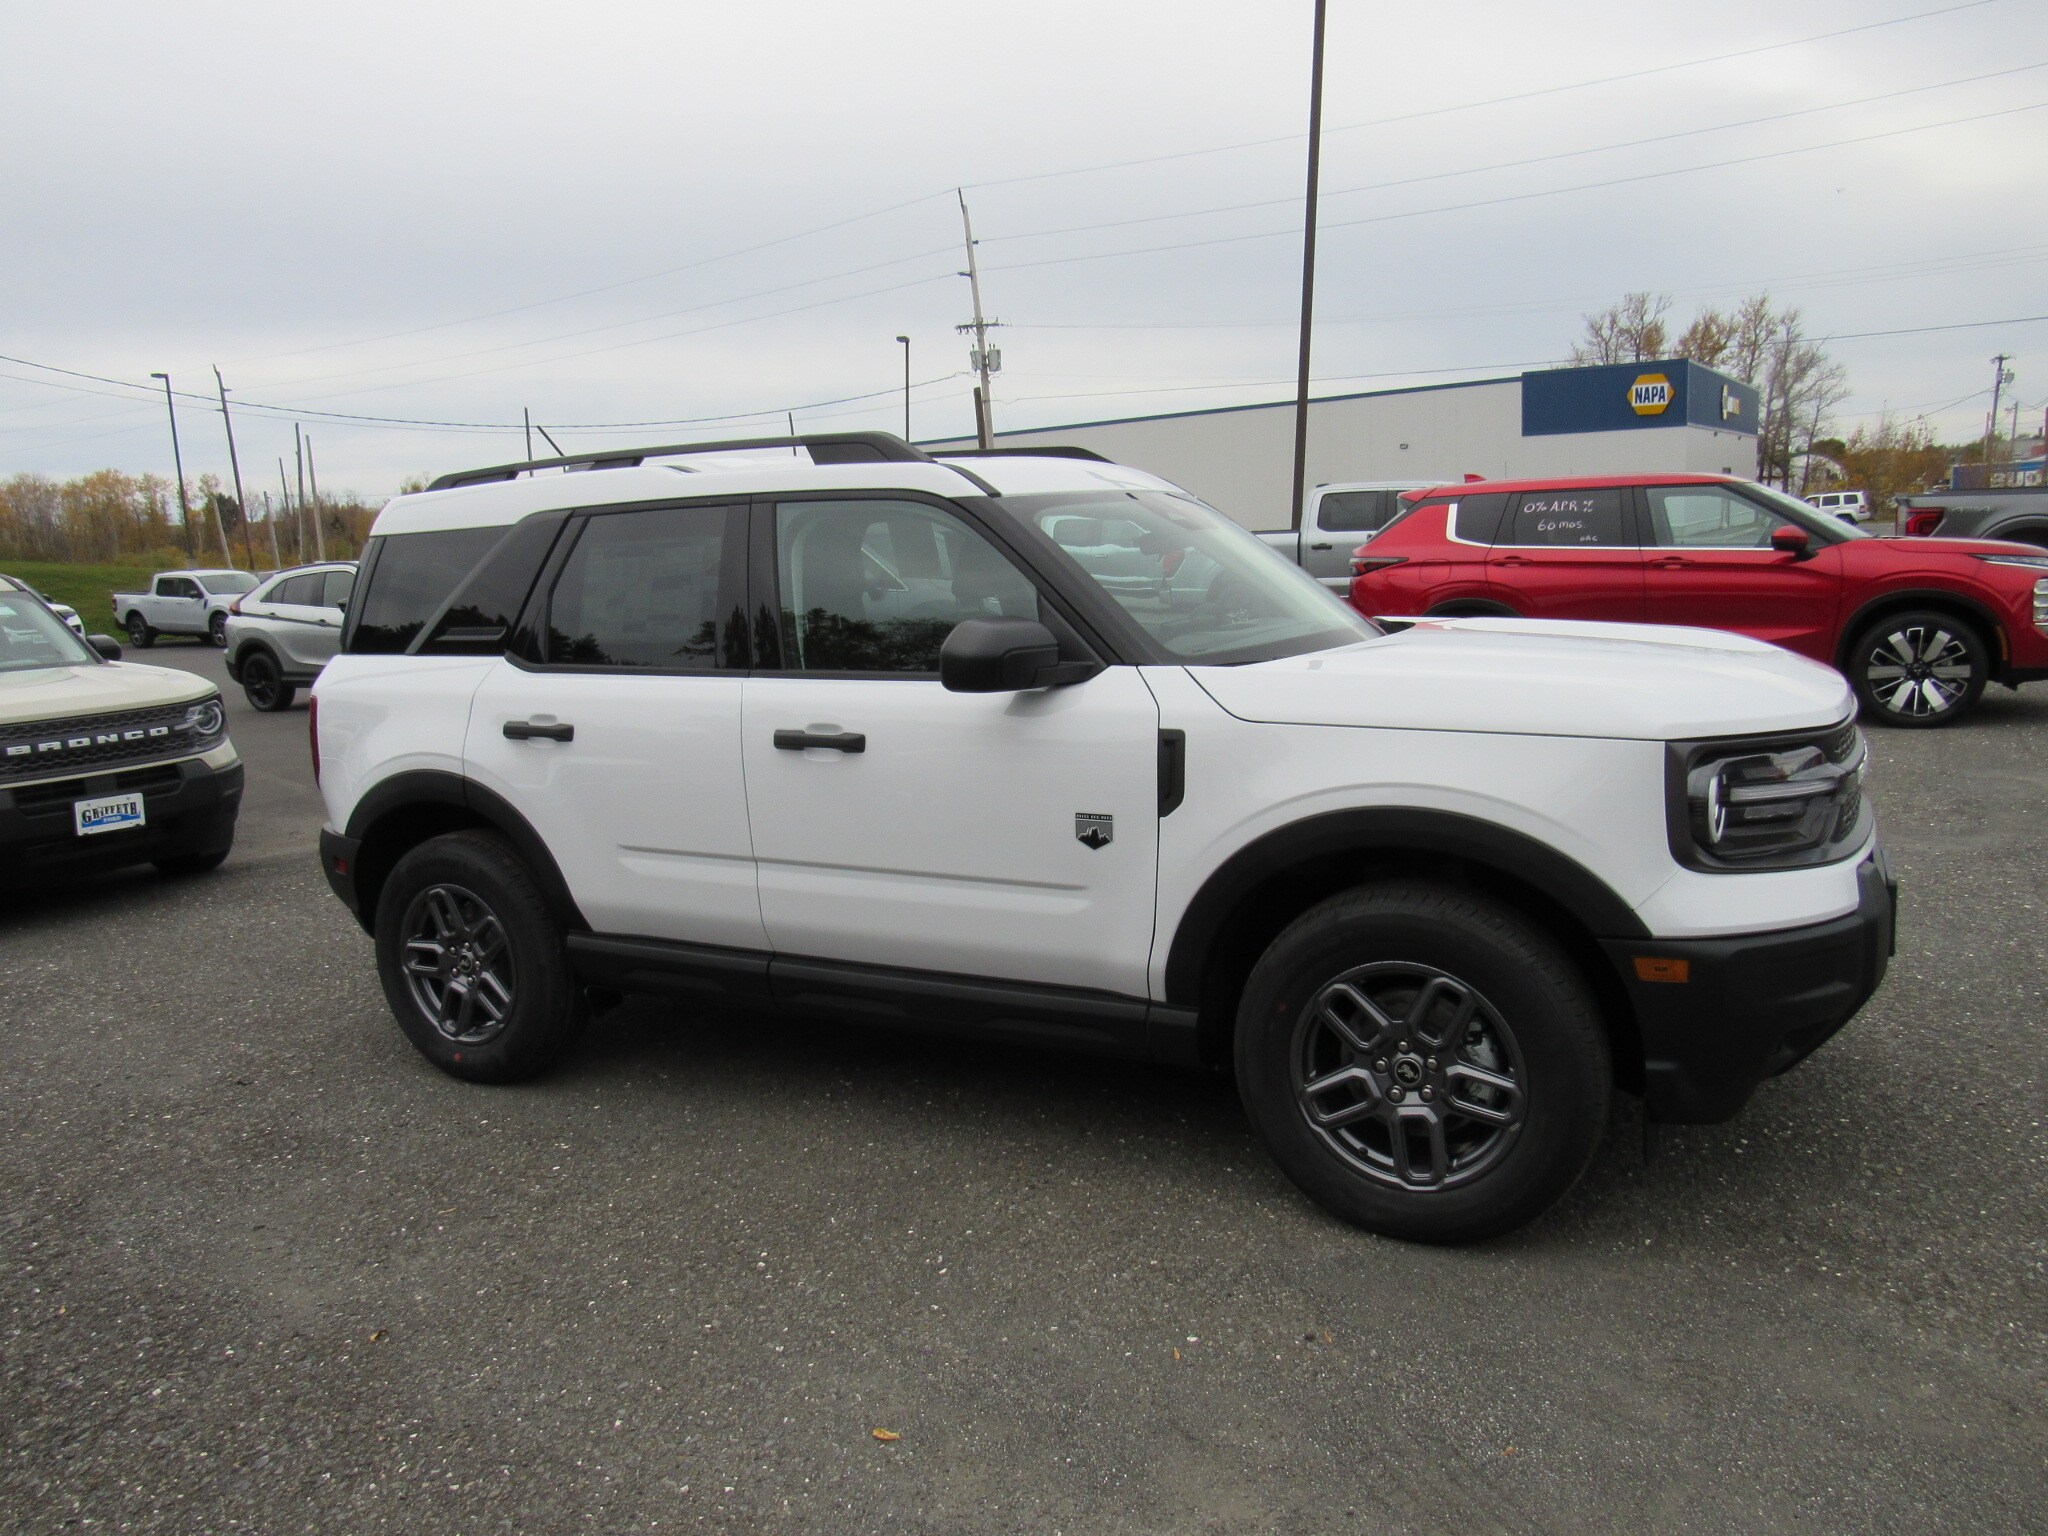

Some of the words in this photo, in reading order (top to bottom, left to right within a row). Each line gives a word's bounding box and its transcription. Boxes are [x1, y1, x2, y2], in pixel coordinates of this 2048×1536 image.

[1635, 386, 1666, 404] NAPA
[1524, 501, 1547, 513] 0%
[1537, 519, 1556, 531] 60
[7, 727, 169, 756] BRONCO
